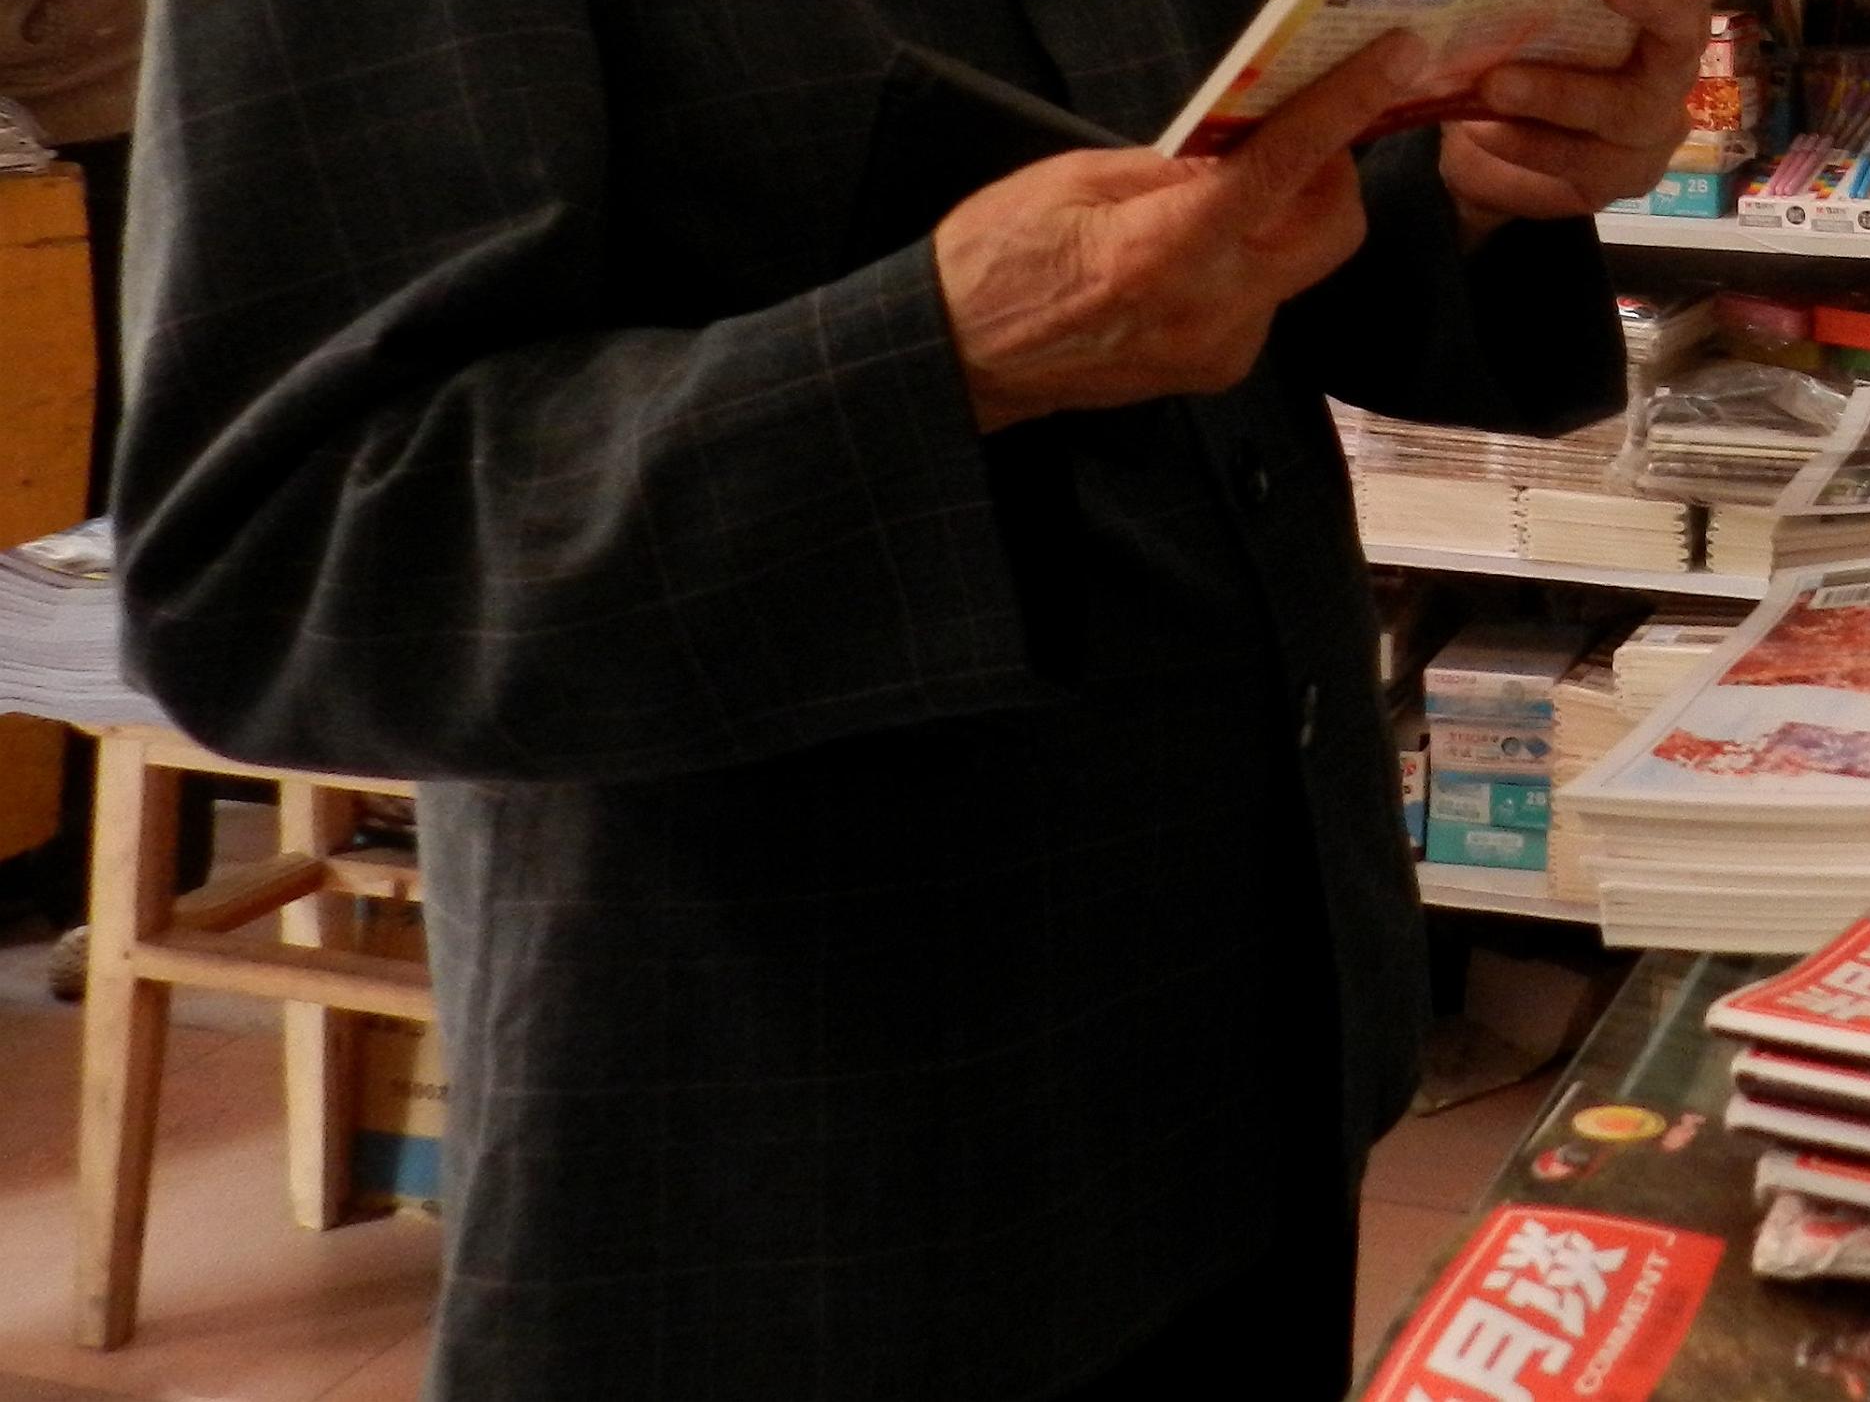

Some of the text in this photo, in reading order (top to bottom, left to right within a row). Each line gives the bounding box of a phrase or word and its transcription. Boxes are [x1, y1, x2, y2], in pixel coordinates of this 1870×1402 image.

[1687, 178, 1708, 194] 2B
[1404, 1218, 1630, 1402] 月谈
[1574, 1247, 1670, 1396] COMMENT
